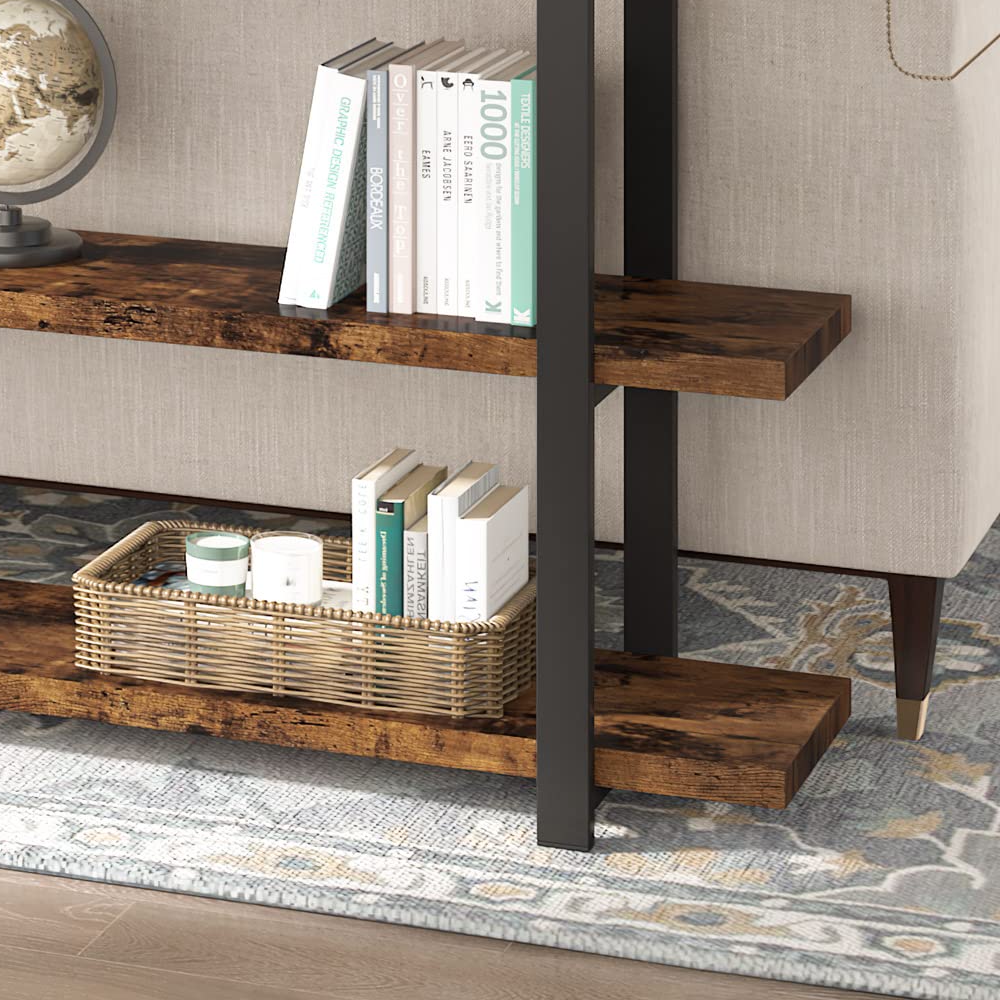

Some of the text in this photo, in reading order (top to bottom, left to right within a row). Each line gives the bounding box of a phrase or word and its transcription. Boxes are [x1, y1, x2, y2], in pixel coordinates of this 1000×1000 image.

[480, 89, 508, 160] 1000
[520, 93, 530, 124] TEXTILE
[313, 96, 351, 264] GRAPHIC DESIGN REFERENCED
[369, 167, 383, 229] BORDEAUX
[421, 150, 431, 179] EAMES
[442, 131, 452, 202] ARNE JACOBSEN
[463, 135, 473, 204] EERO SAARINEN
